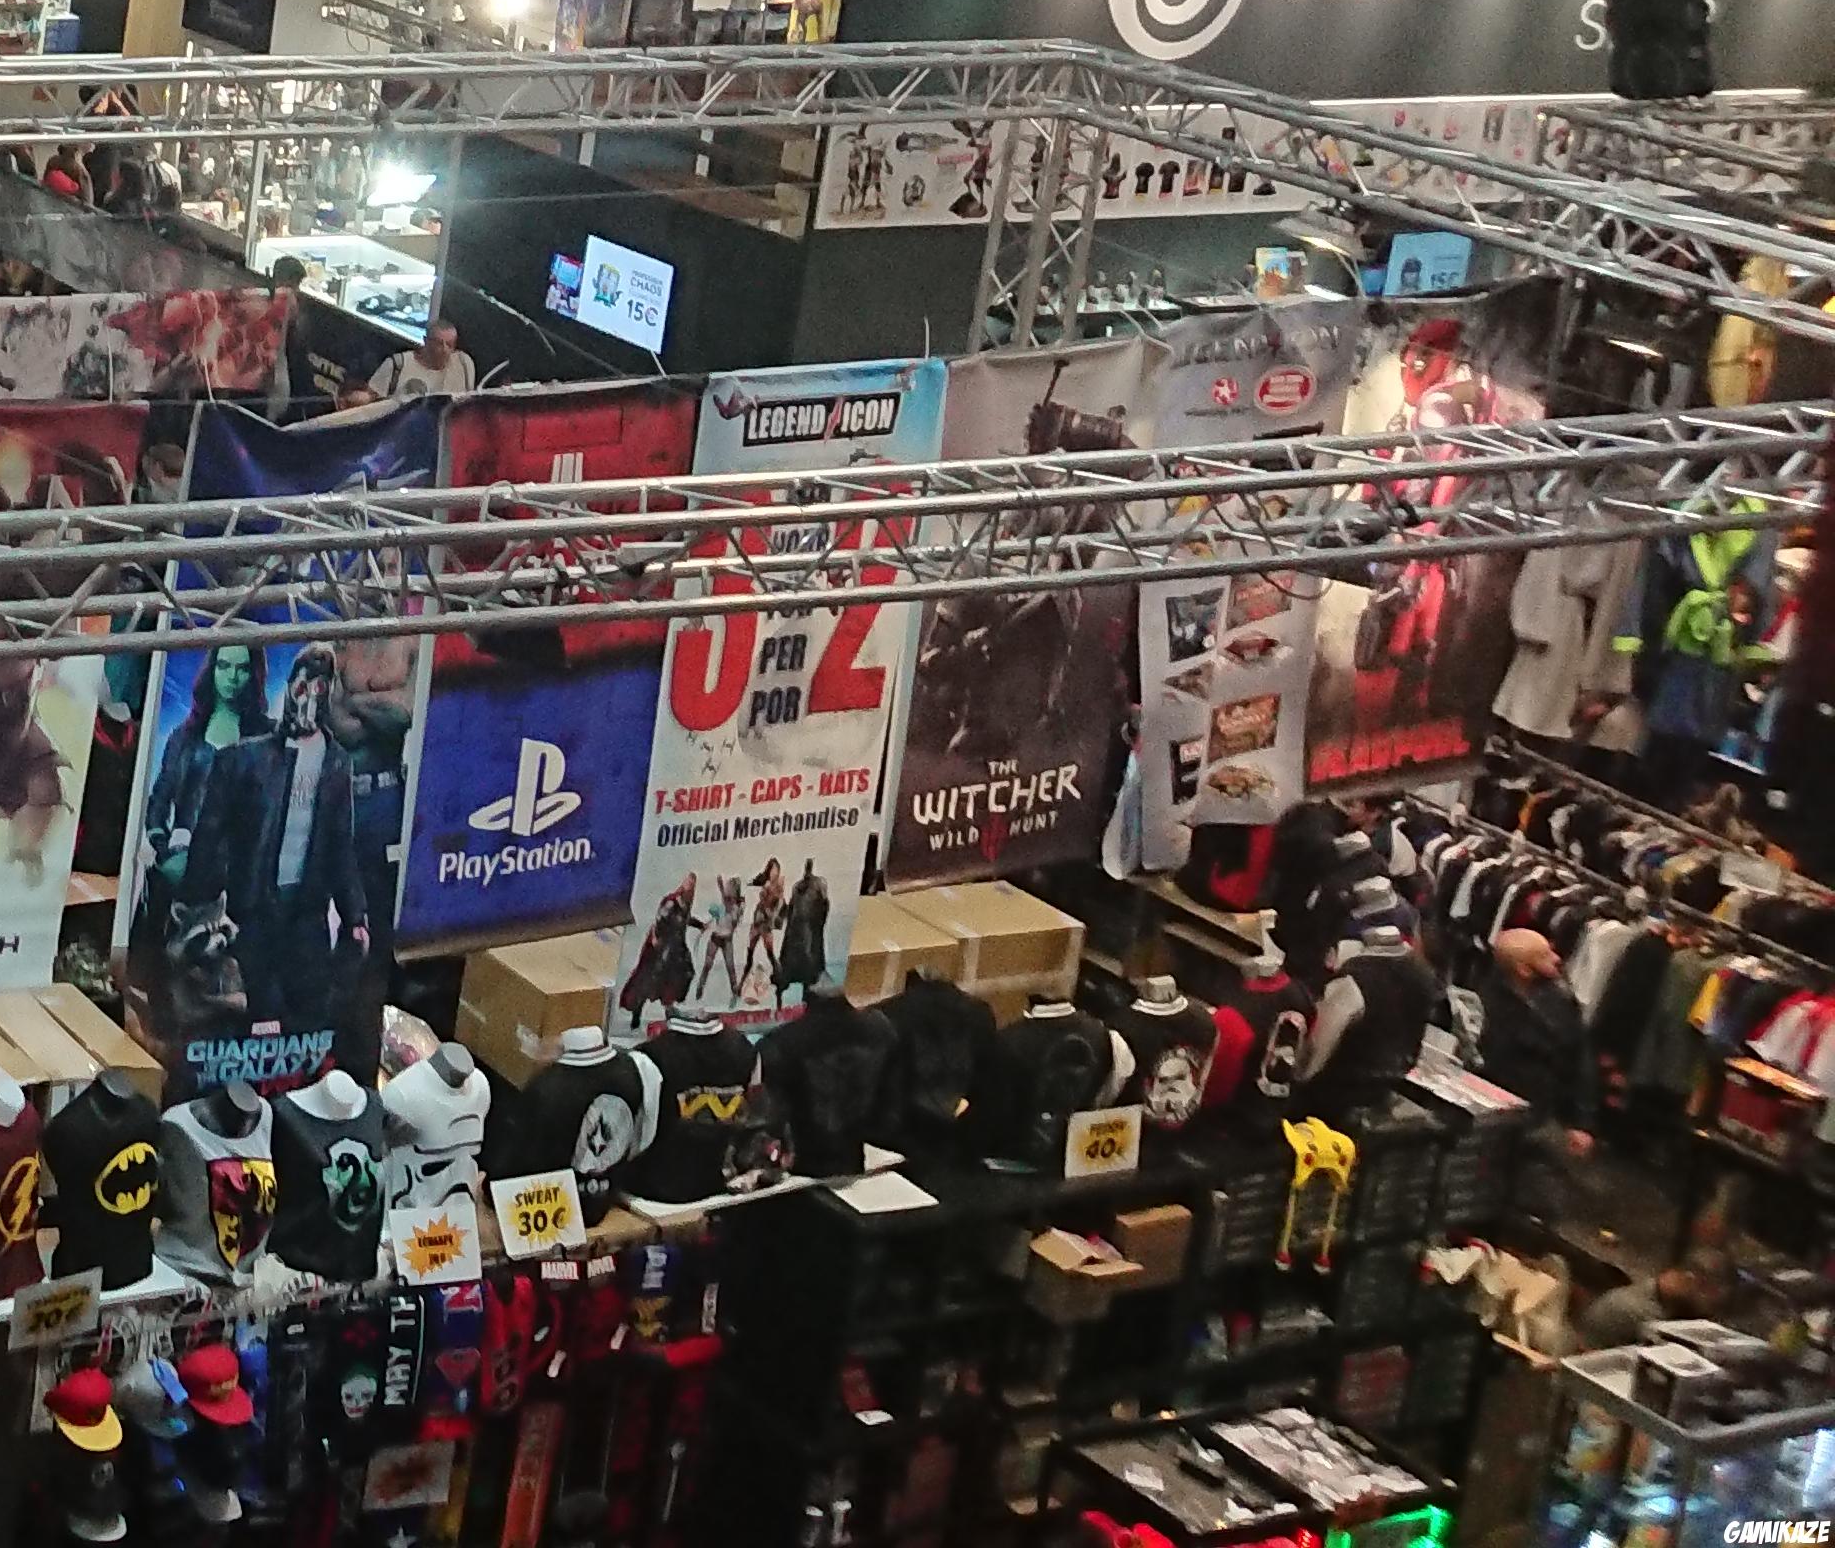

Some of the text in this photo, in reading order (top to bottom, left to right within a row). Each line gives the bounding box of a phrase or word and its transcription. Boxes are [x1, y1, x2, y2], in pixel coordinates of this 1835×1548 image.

[747, 397, 895, 440] LEGEND ICON
[761, 633, 808, 675] PER
[748, 684, 802, 727] POR
[987, 759, 1018, 776] THE
[655, 782, 736, 814] T-SHIRT
[750, 774, 802, 805] CAPS
[818, 767, 870, 797] HATS
[913, 763, 1082, 826] WITCHER
[657, 805, 859, 848] Official Merchandise
[929, 810, 1058, 851] WILD HUNT
[439, 835, 593, 886] PlayStation
[186, 1030, 335, 1065] GUARDIANS
[219, 1049, 328, 1083] GALAXY
[514, 1187, 561, 1208] SWEAT
